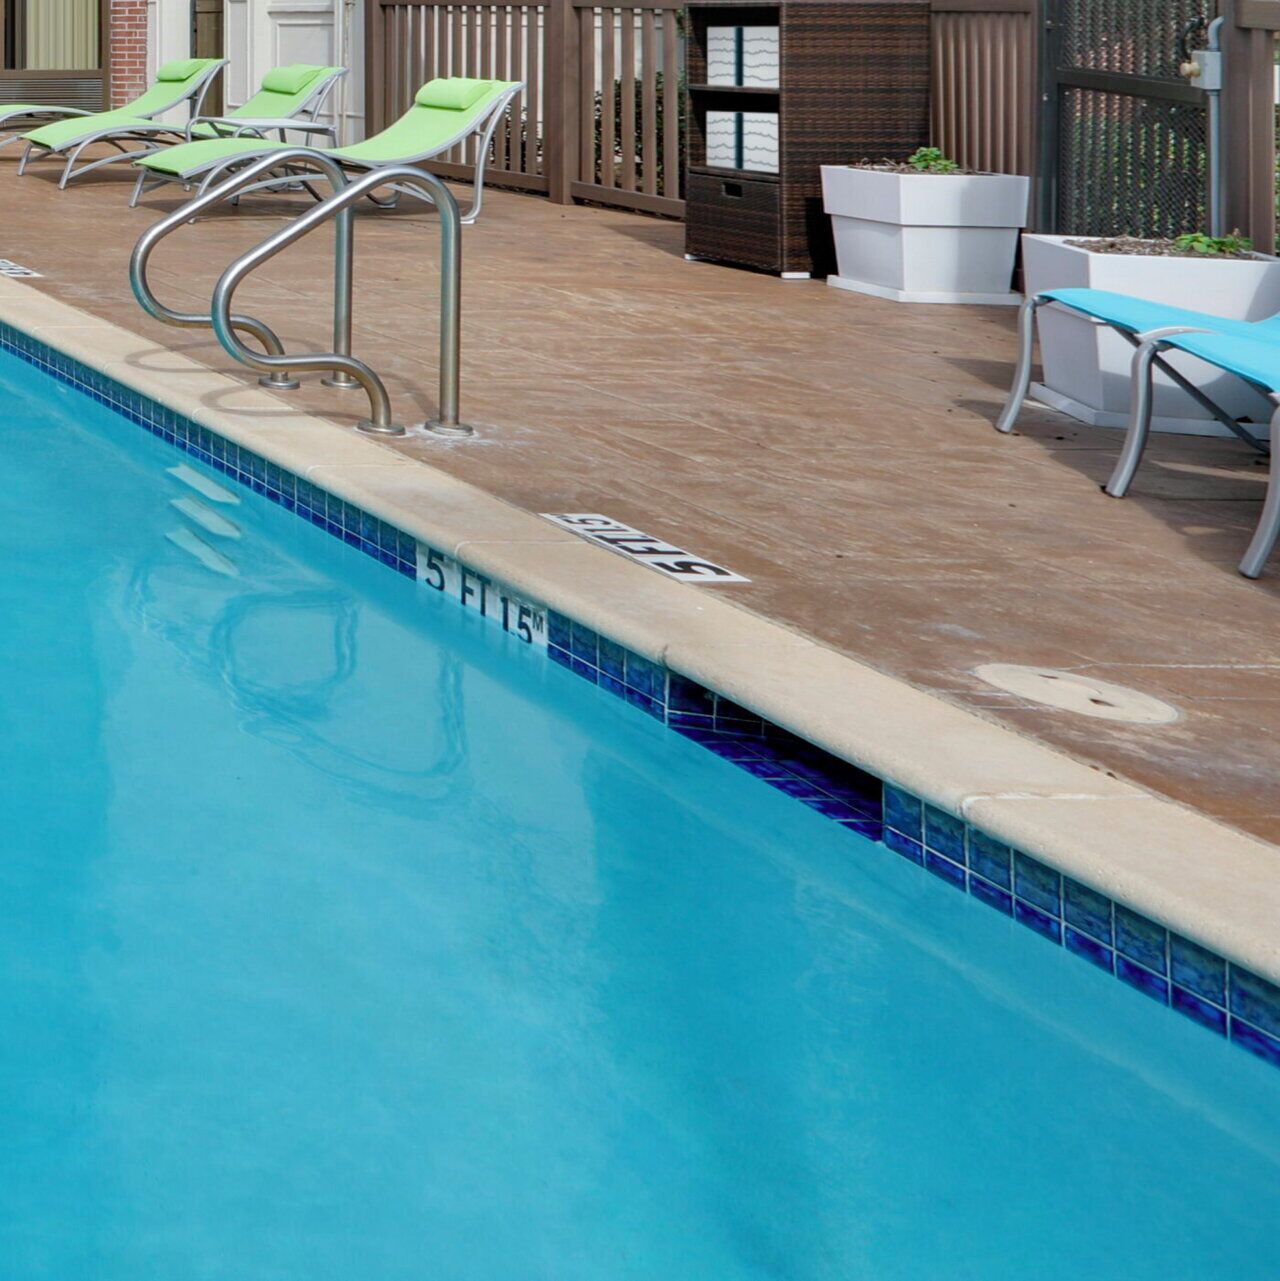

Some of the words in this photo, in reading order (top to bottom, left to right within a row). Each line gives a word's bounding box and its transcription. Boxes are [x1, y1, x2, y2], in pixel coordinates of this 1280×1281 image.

[425, 548, 445, 592] 5
[461, 565, 492, 617] FT
[651, 561, 731, 576] 5
